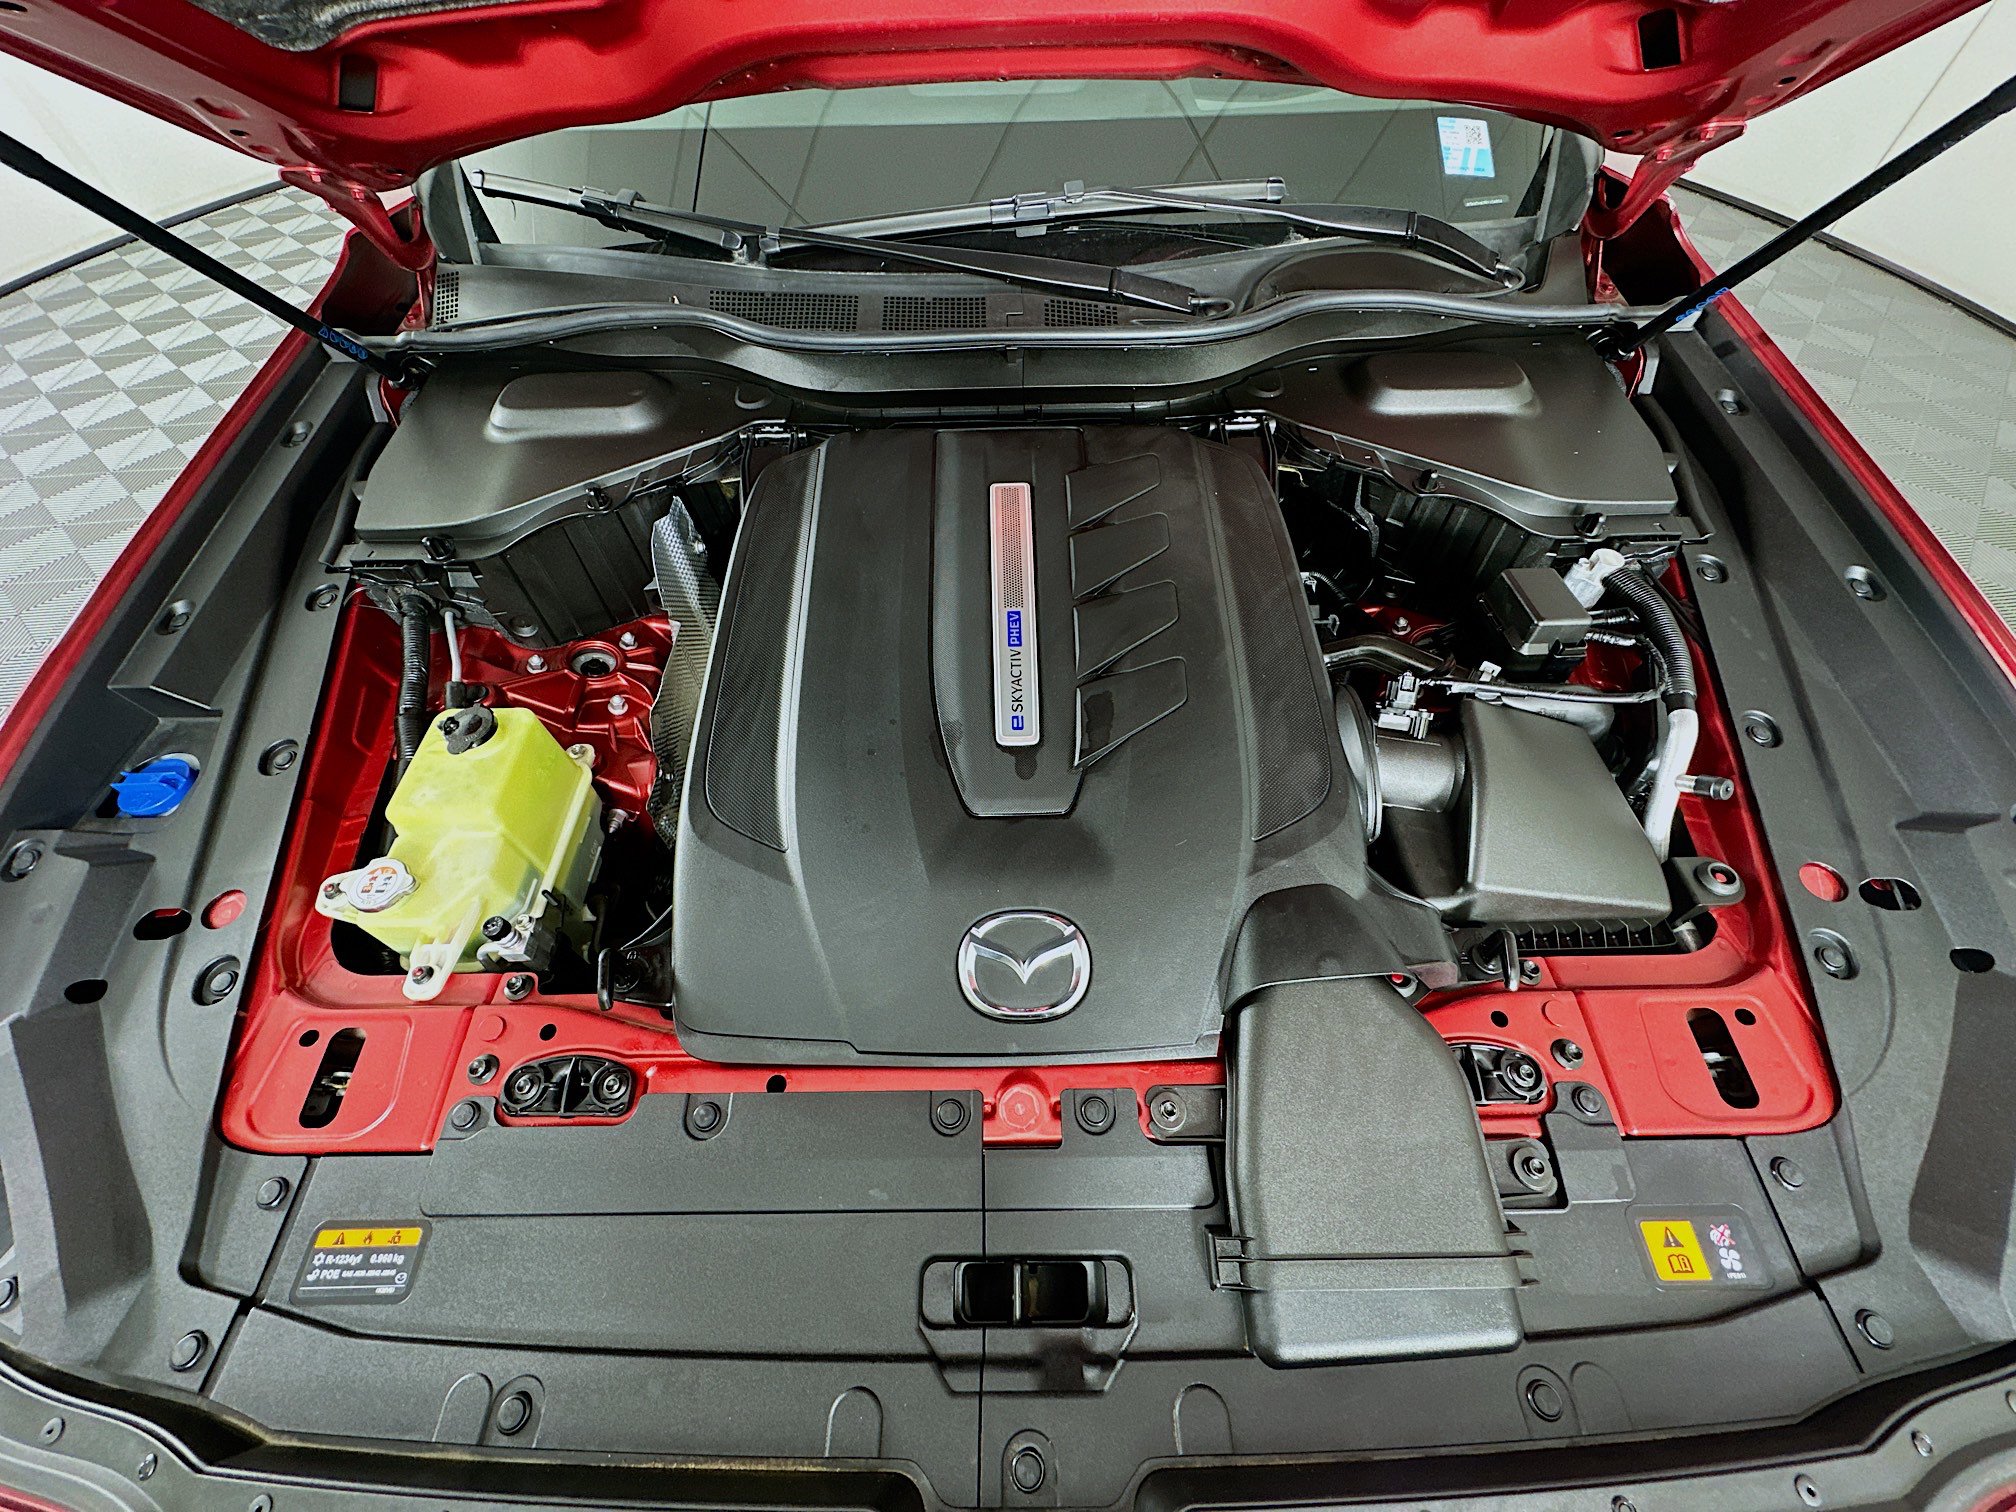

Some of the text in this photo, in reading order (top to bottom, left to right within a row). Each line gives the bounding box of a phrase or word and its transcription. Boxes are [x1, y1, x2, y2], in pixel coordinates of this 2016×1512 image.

[1009, 612, 1020, 645] PHEV
[1010, 648, 1024, 713] SKYACTIV
[393, 1253, 405, 1265] kg
[320, 1269, 341, 1279] POE
